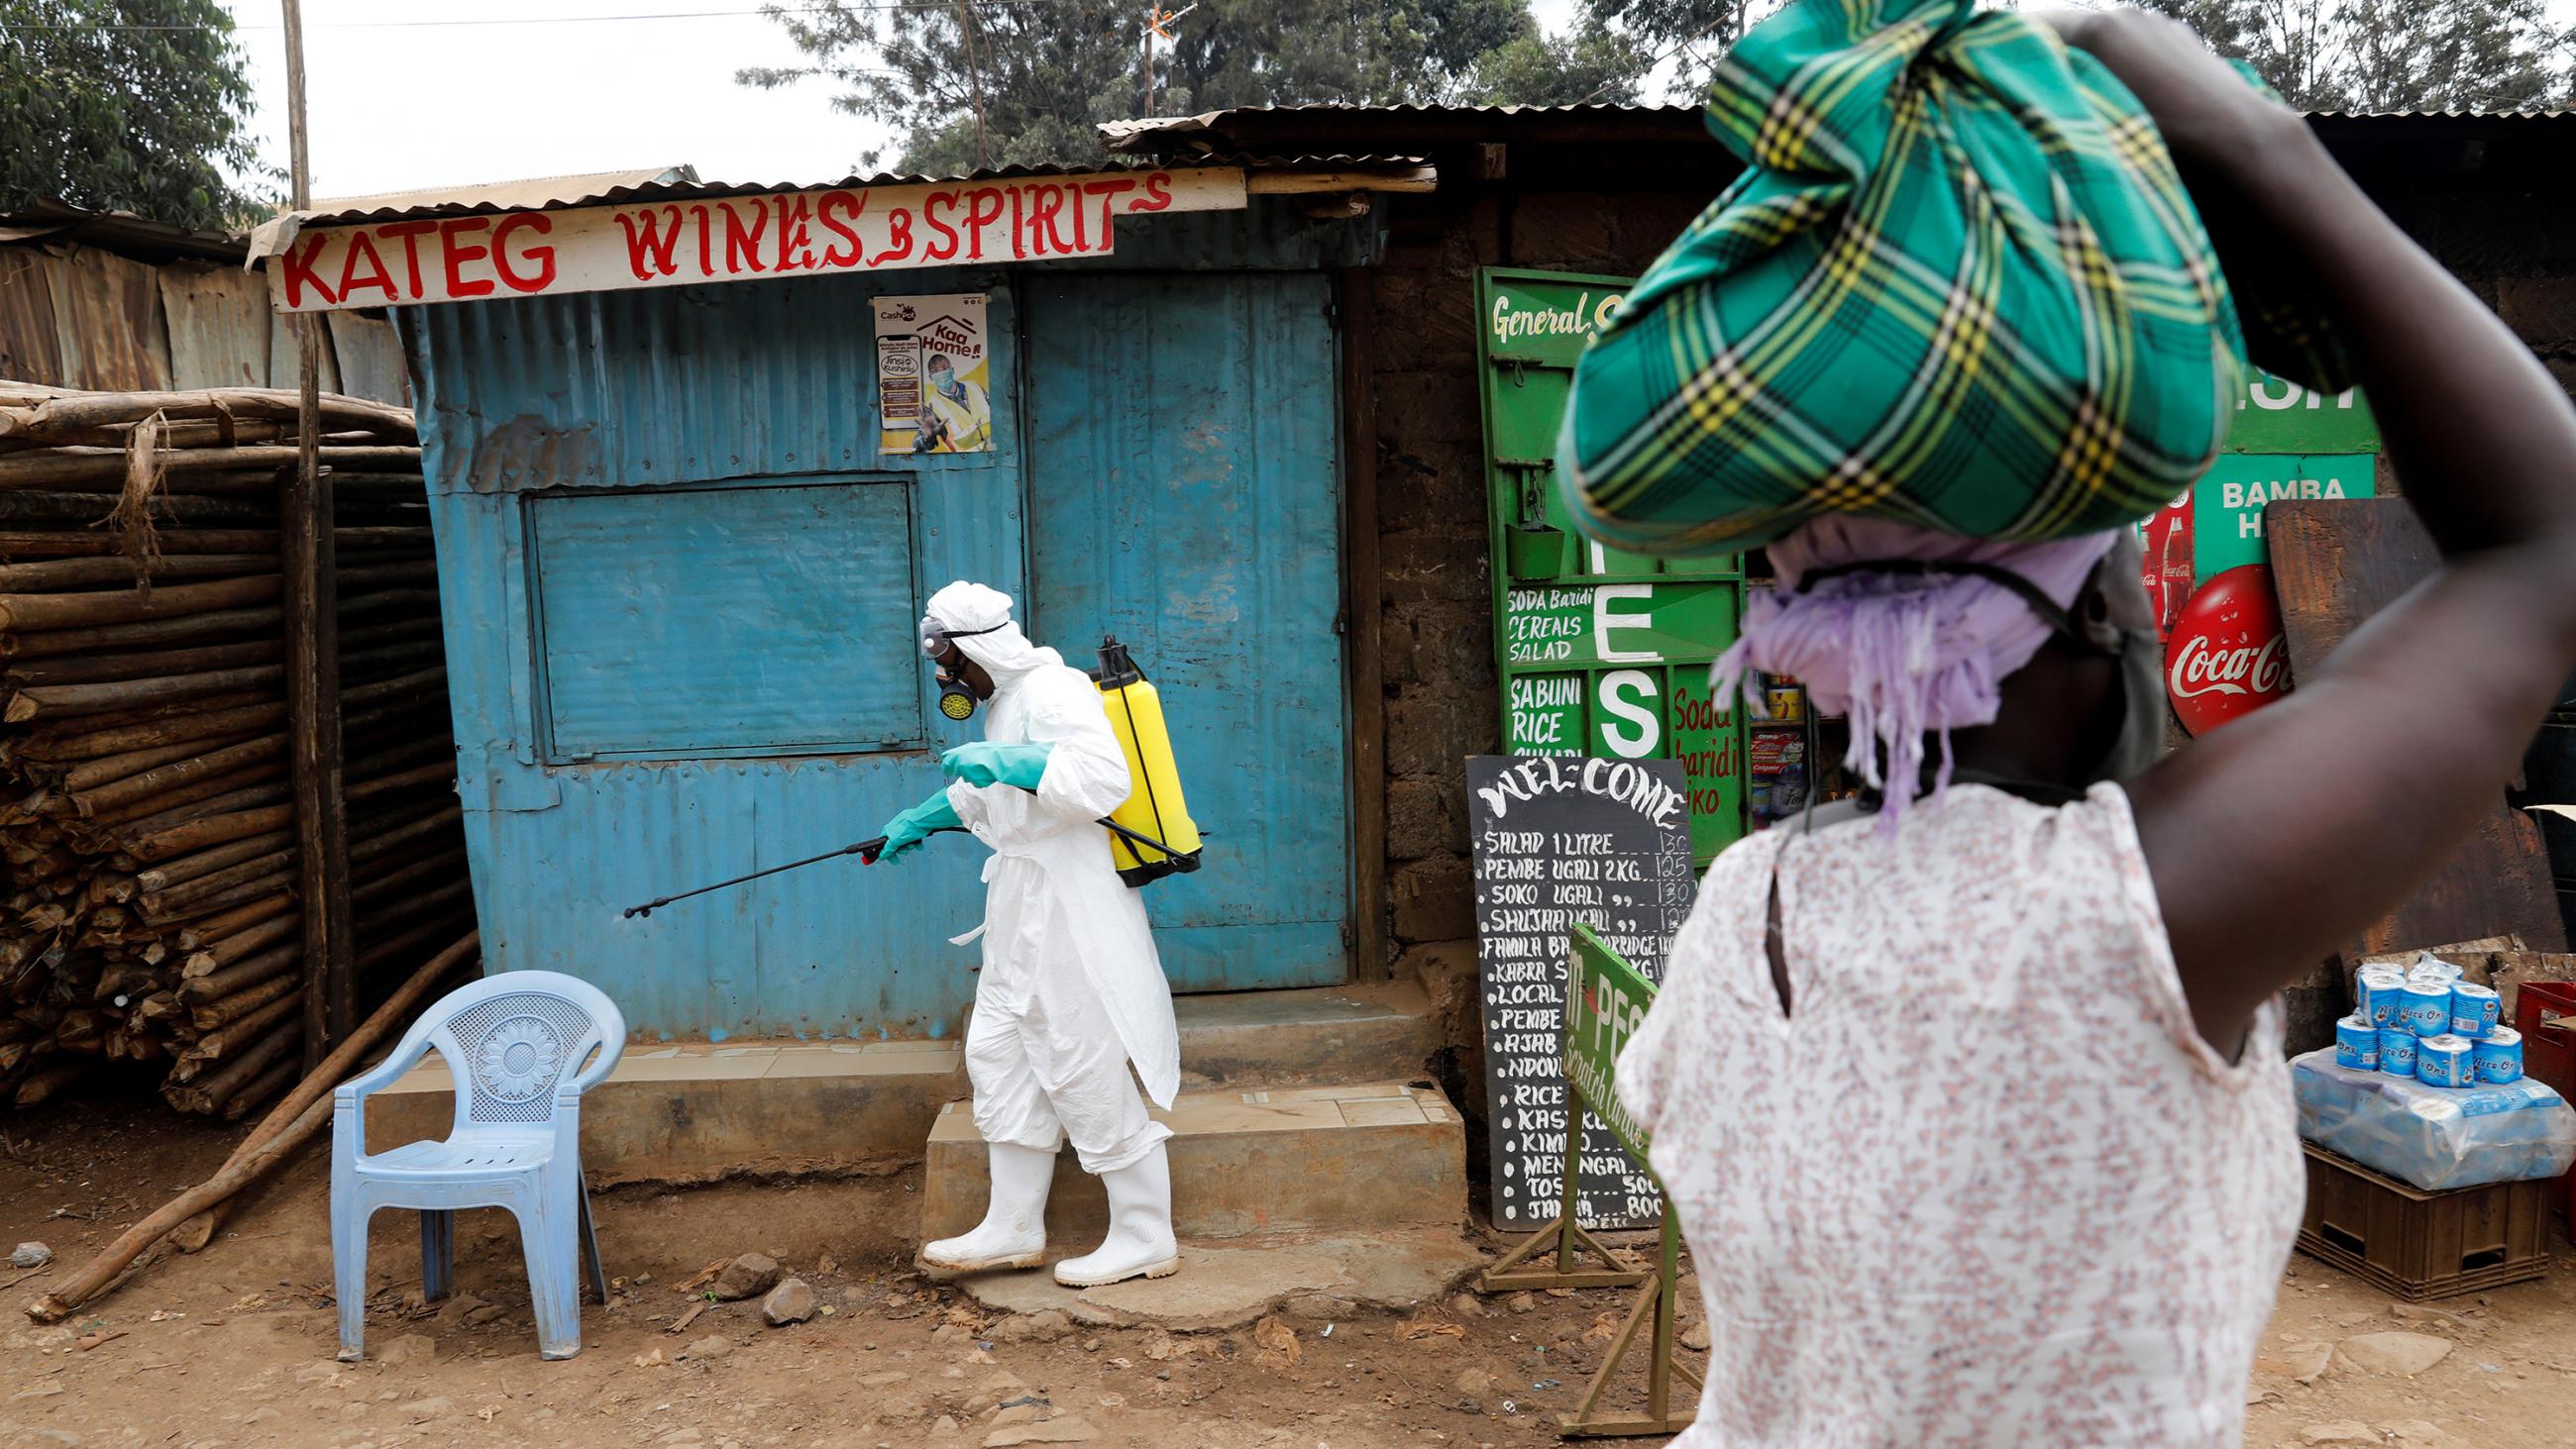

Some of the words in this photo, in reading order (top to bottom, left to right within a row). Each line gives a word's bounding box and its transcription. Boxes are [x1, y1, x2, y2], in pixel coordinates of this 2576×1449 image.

[282, 212, 557, 307] KATEG
[920, 172, 1173, 265] SPIRITS
[935, 324, 968, 346] Kaa
[2222, 478, 2346, 509] BAMBA
[1508, 589, 1547, 613] SODA
[1550, 586, 1594, 610] Baridi
[1508, 615, 1582, 641] CEREALS
[1509, 641, 1572, 662] SALAD
[1510, 677, 1581, 711] SABUNI
[1512, 711, 1564, 745] RICE
[1753, 764, 1780, 773] Colgate
[1484, 831, 1545, 855] SALAD
[1564, 833, 1614, 855] LITRE
[1484, 858, 1545, 880] PEMBE
[1552, 859, 1599, 880] UGALI
[1605, 860, 1640, 881] 2KG
[1656, 855, 1686, 878] 125
[1491, 883, 1539, 905] SOKO
[1553, 884, 1603, 906] UGALI
[1490, 908, 1565, 933] SHUJAA
[1495, 961, 1546, 983] KABRA
[1497, 984, 1563, 1005] LOCAL
[1500, 1008, 1561, 1030] PEMBE
[1504, 1033, 1556, 1054] AJAB
[1563, 1035, 1606, 1110] Scratch
[2425, 1063, 2448, 1077] One
[1514, 1085, 1563, 1105] RICE
[1522, 1132, 1591, 1153] KIMO
[1523, 1155, 1627, 1179] MENNGAI
